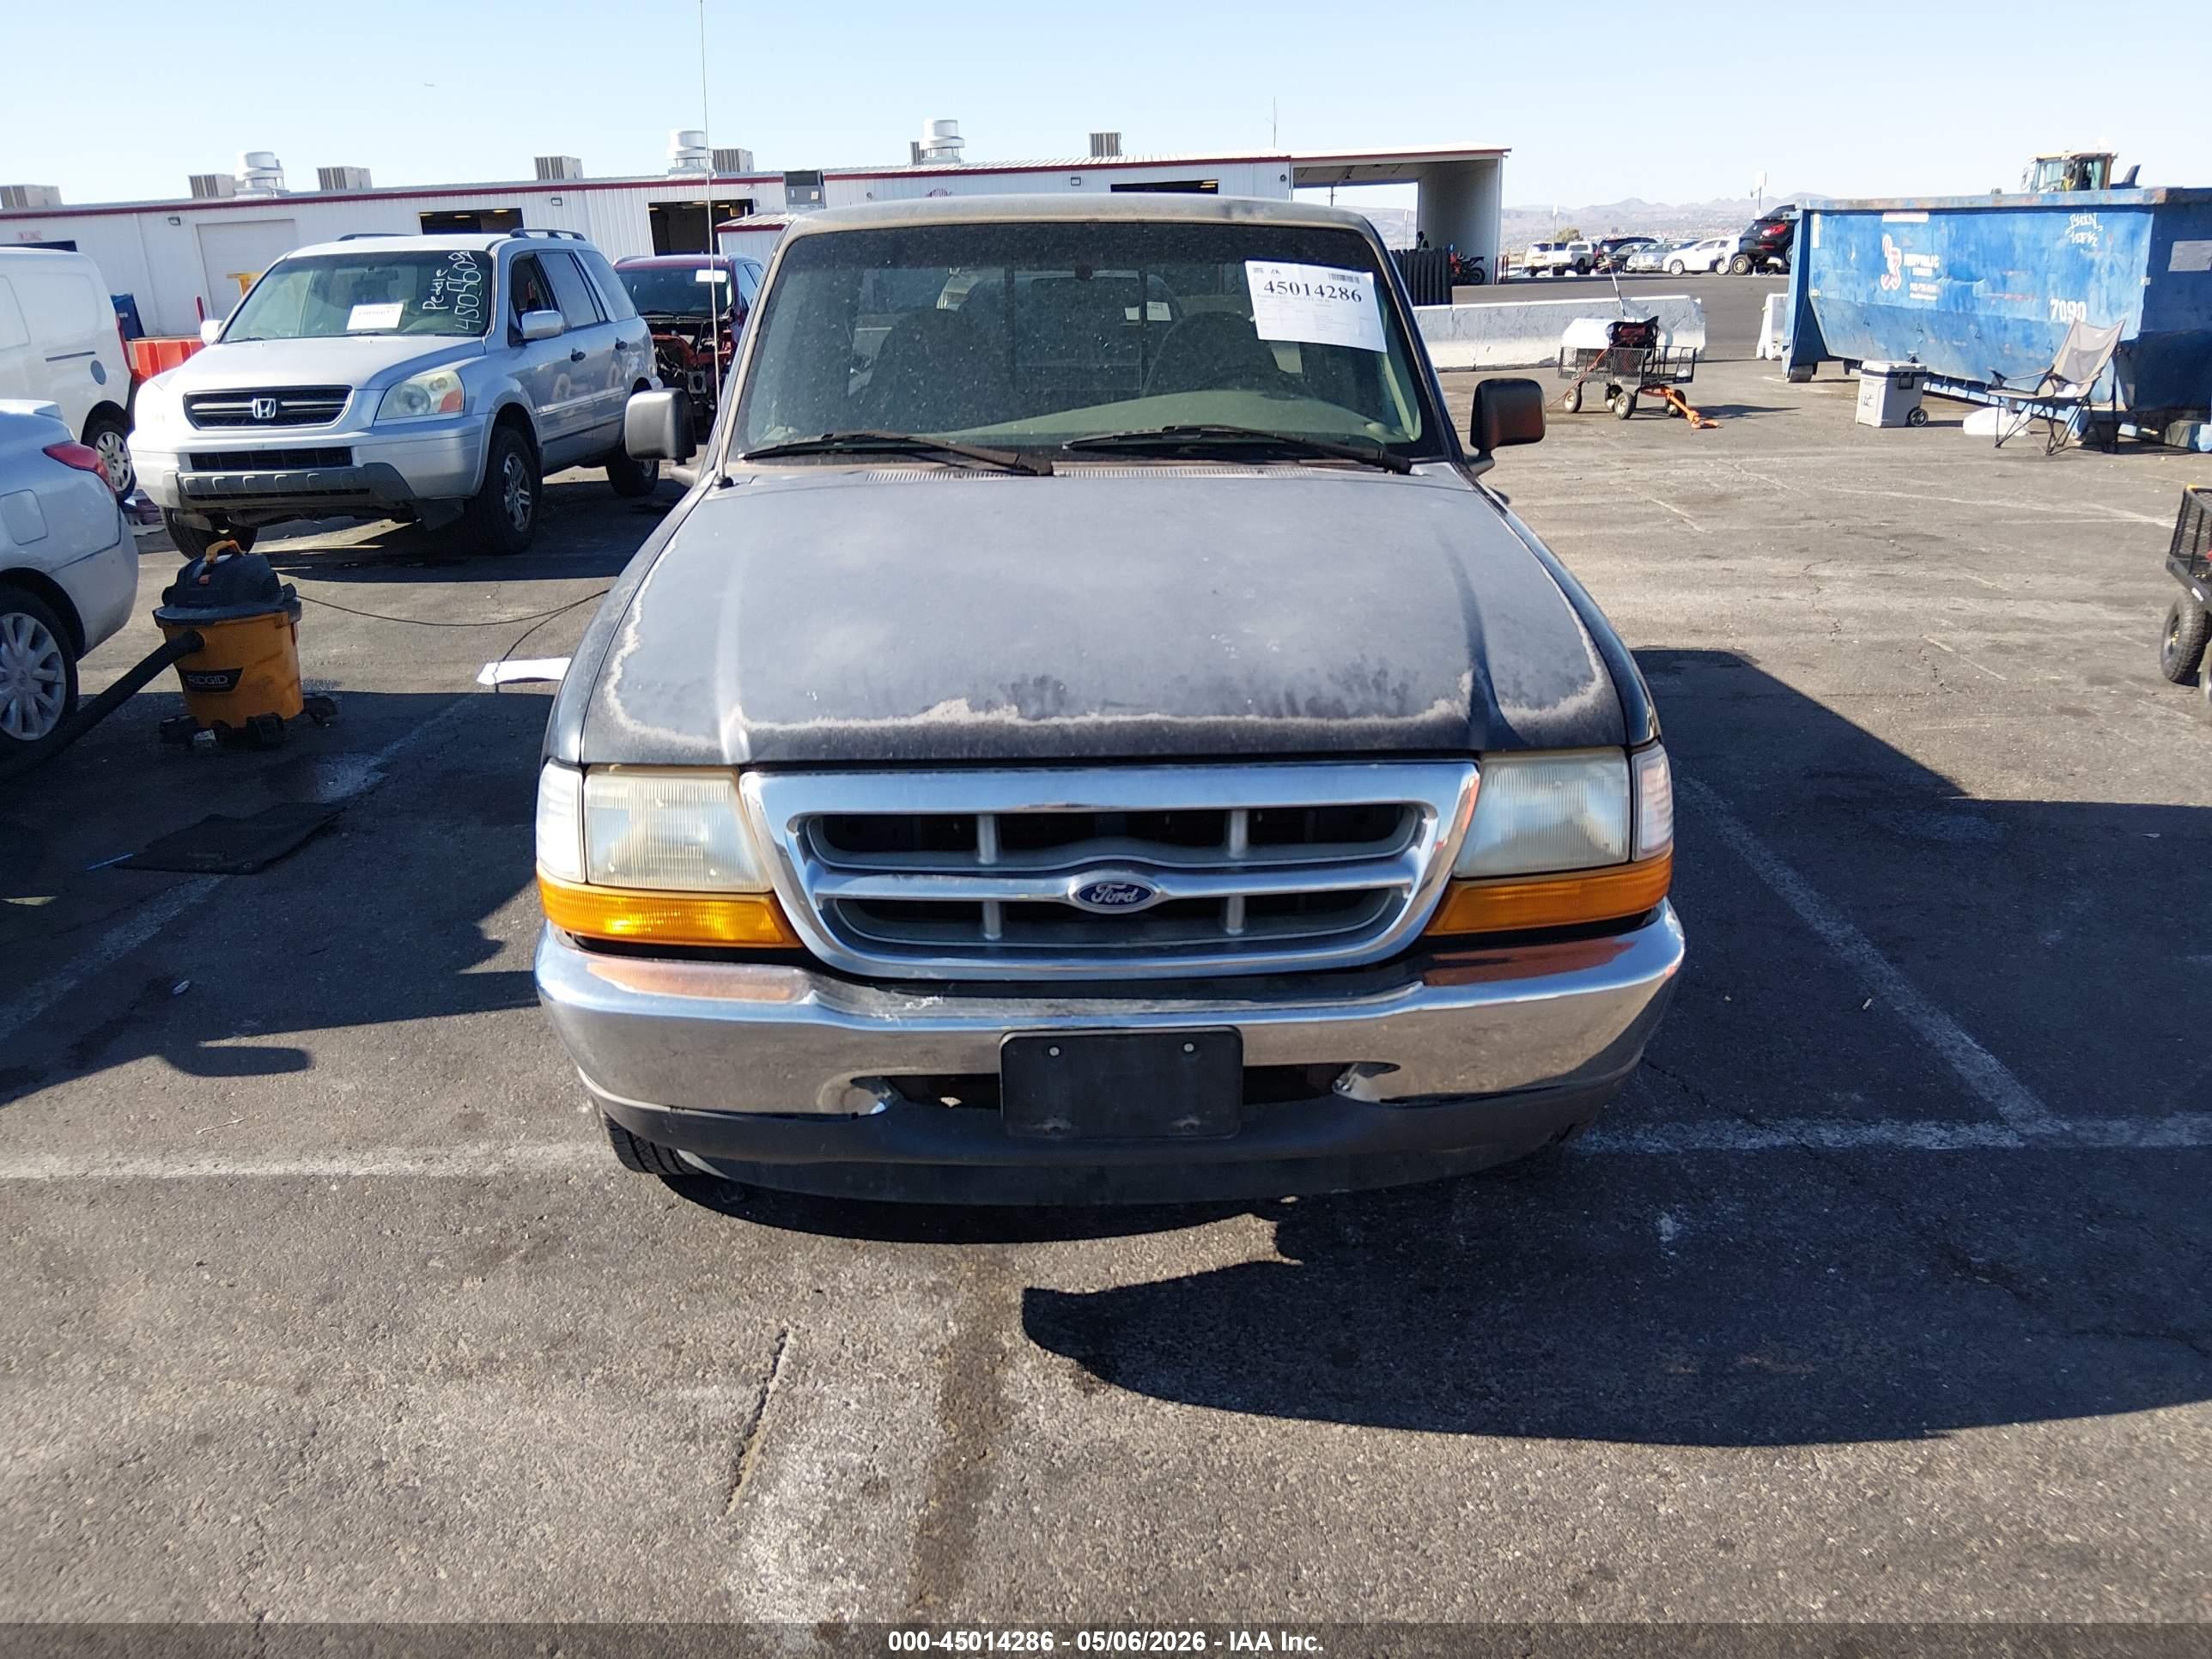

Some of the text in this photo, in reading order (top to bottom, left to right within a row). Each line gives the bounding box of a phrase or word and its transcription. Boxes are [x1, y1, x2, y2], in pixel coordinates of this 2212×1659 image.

[422, 268, 449, 310] Peddle
[1263, 280, 1363, 303] 45014286
[2049, 298, 2087, 324] 7090
[186, 674, 228, 685] RIDGID
[1091, 883, 1139, 904] Ford
